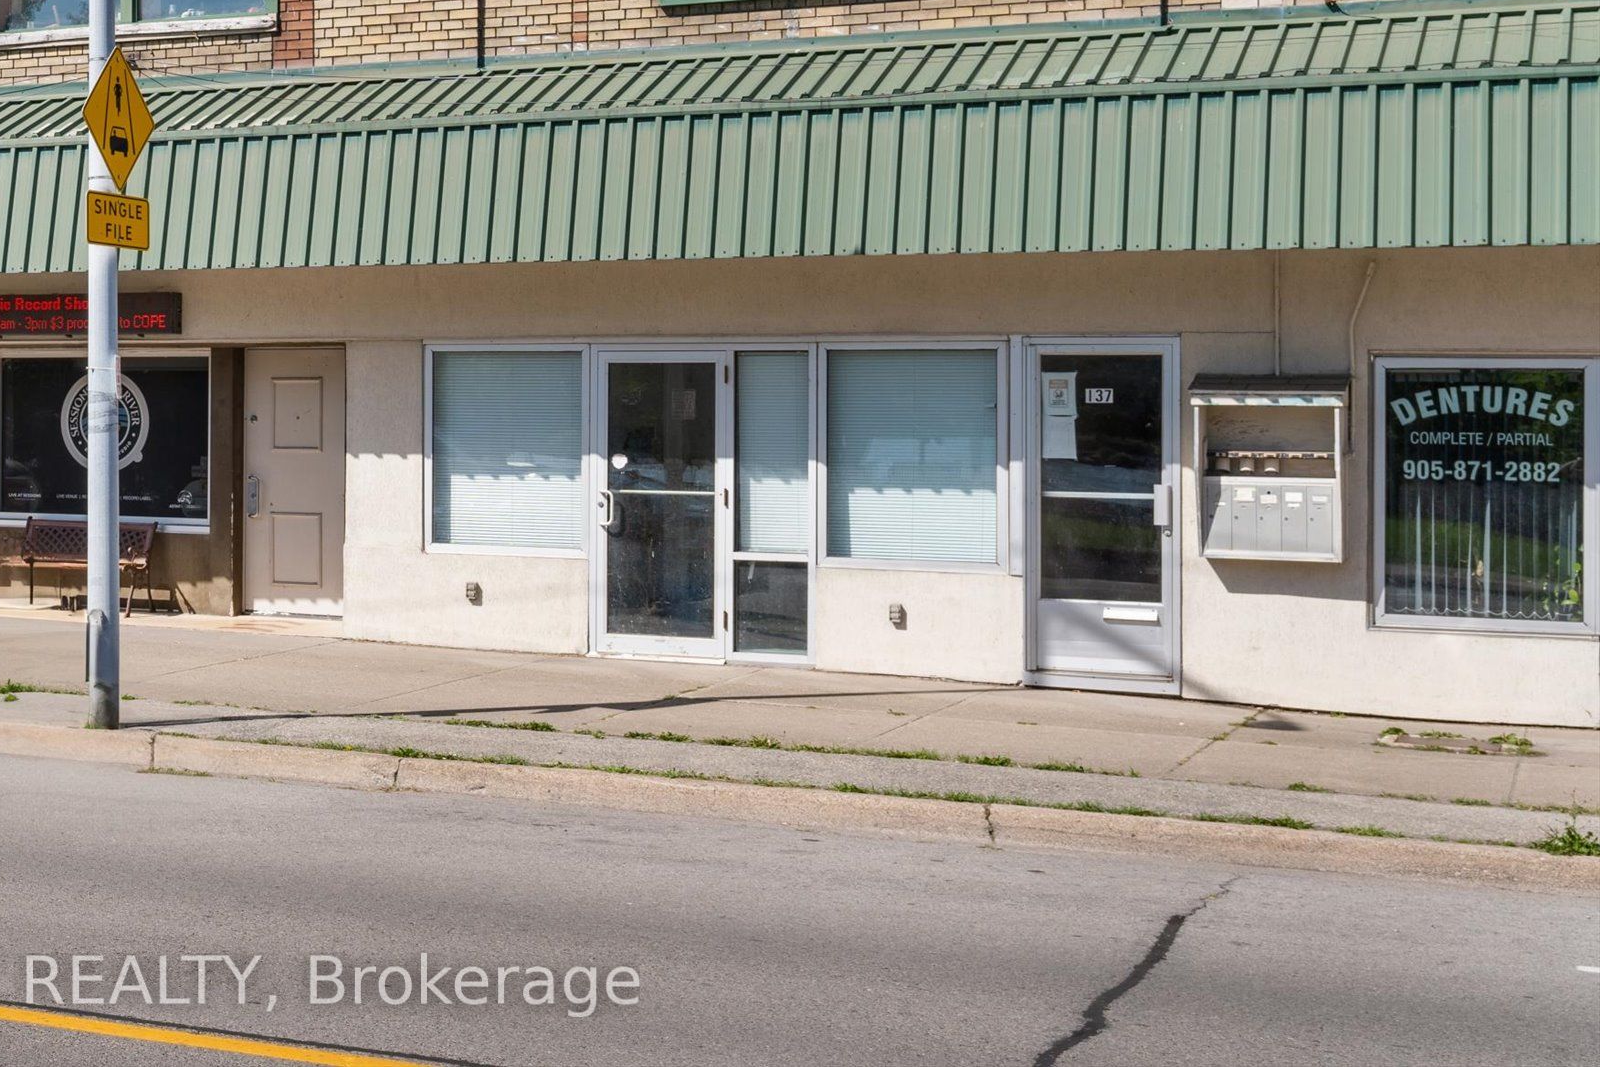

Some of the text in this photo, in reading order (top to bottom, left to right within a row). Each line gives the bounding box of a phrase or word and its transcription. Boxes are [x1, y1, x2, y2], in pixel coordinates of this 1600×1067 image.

[94, 199, 142, 220] SINGLE
[105, 223, 132, 241] FILE
[14, 297, 61, 312] Record
[65, 296, 89, 311] Sho
[24, 316, 48, 331] 3pm
[50, 315, 64, 330] $3
[118, 316, 131, 329] to
[133, 314, 167, 329] COPE
[1089, 389, 1112, 402] 137
[122, 390, 140, 426] RIVER
[1390, 385, 1575, 427] DENTURES
[1410, 431, 1484, 445] COMPLETE
[1497, 432, 1554, 446] PARTIAL
[1403, 460, 1561, 482] 905-871-2882
